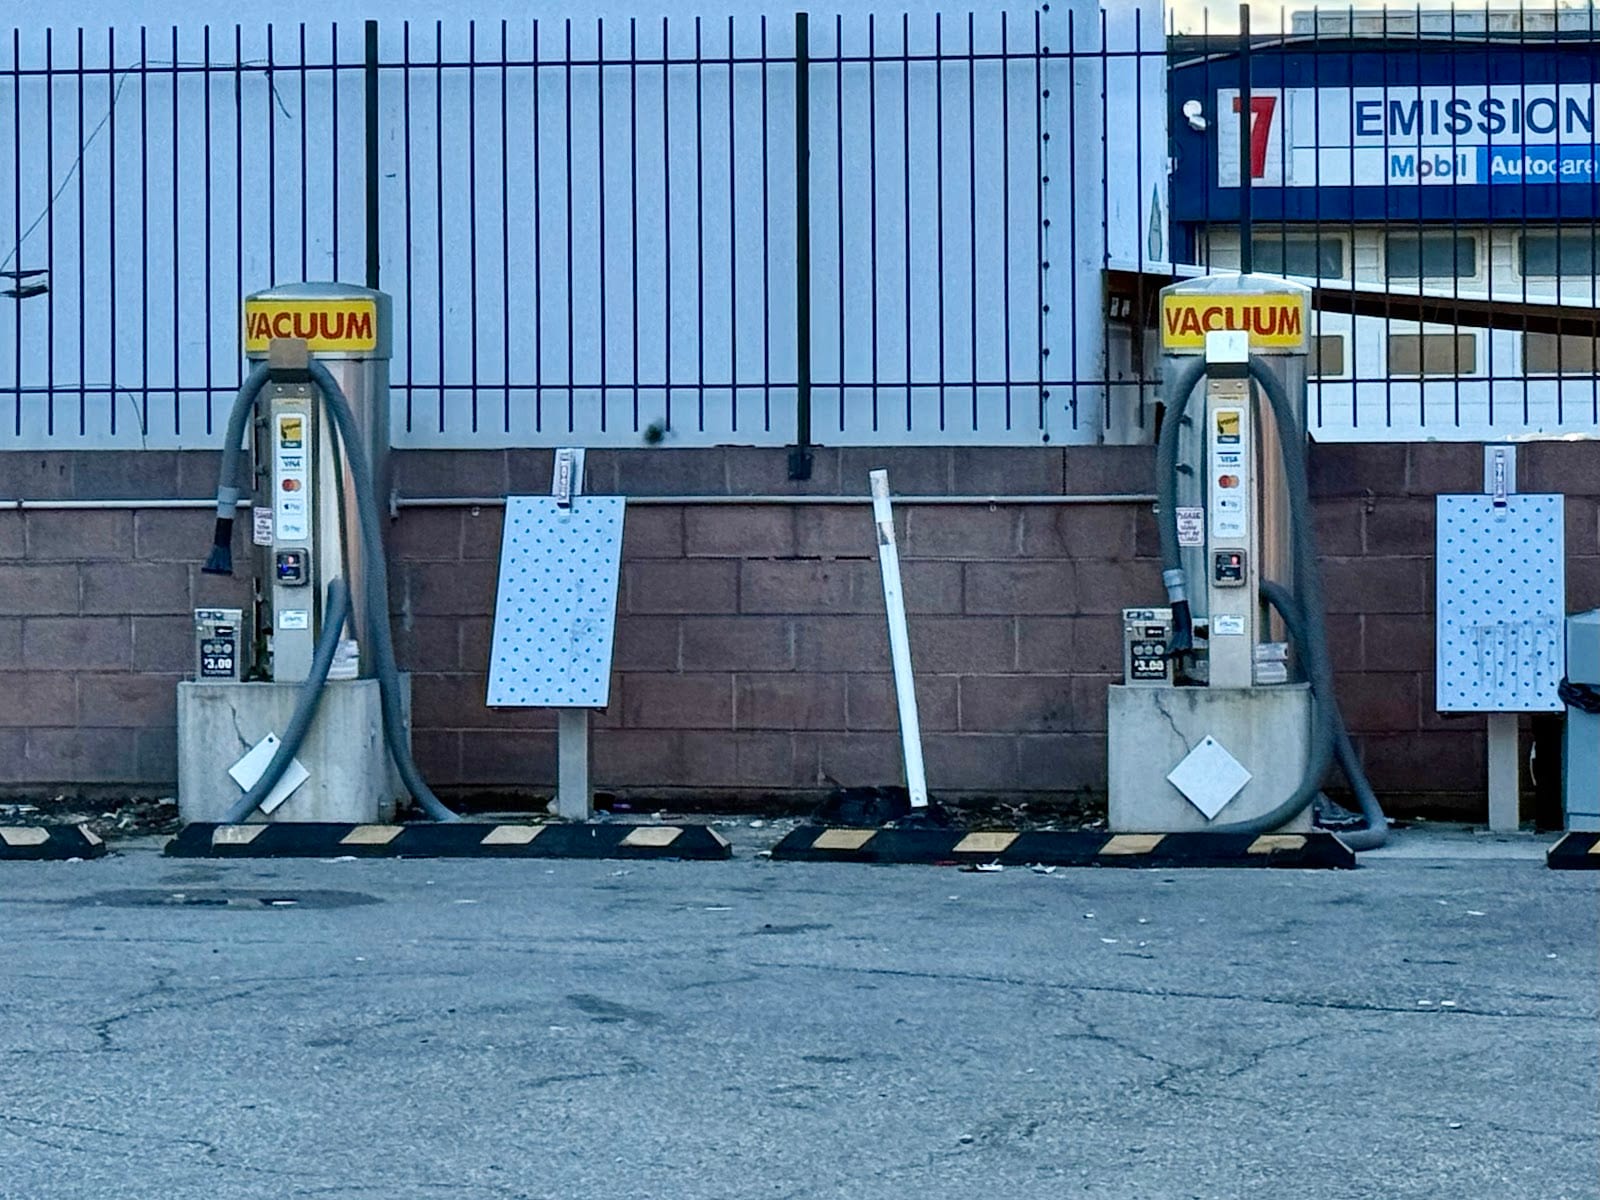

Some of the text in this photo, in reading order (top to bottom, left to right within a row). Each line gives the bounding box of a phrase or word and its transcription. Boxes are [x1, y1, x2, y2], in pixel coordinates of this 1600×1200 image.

[1356, 97, 1593, 136] EMISSION
[1232, 96, 1277, 178] 7
[1391, 154, 1599, 177] Mobil Autocare
[246, 311, 373, 339] VACUUM
[1165, 307, 1302, 335] VACUUM
